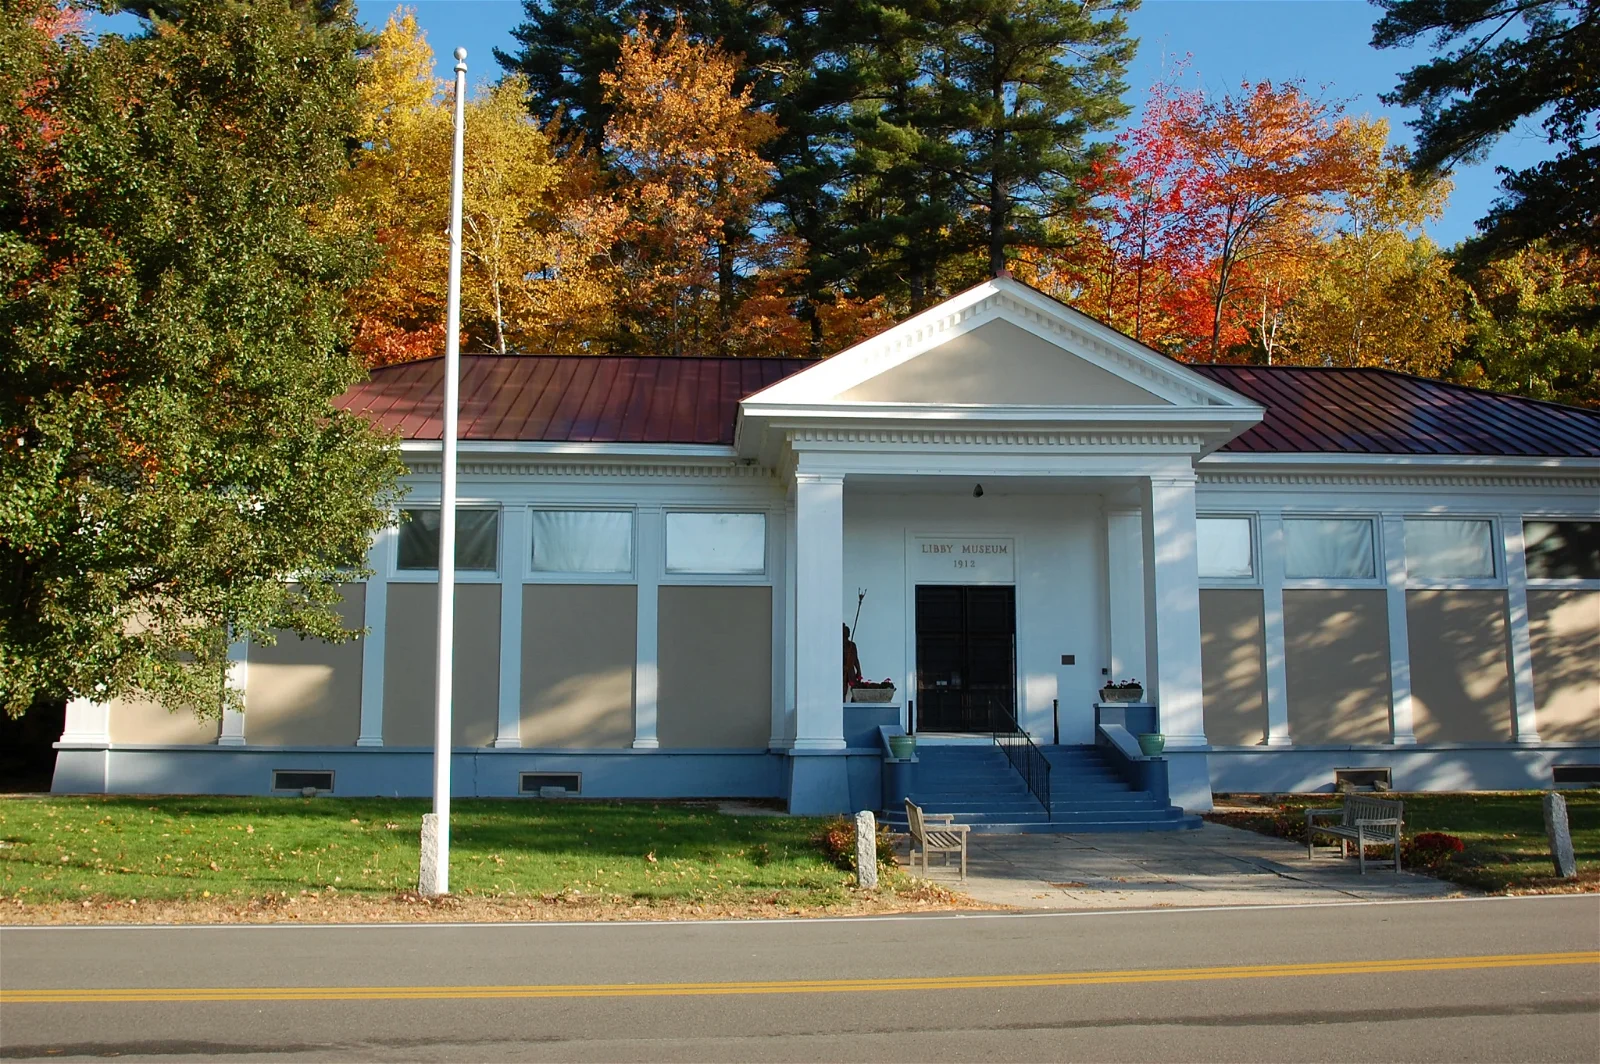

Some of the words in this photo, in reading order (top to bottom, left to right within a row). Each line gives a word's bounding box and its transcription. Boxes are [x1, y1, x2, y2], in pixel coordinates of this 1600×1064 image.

[921, 543, 954, 554] LIBBY
[961, 544, 1008, 554] MUSEUM
[953, 559, 976, 569] 1912
